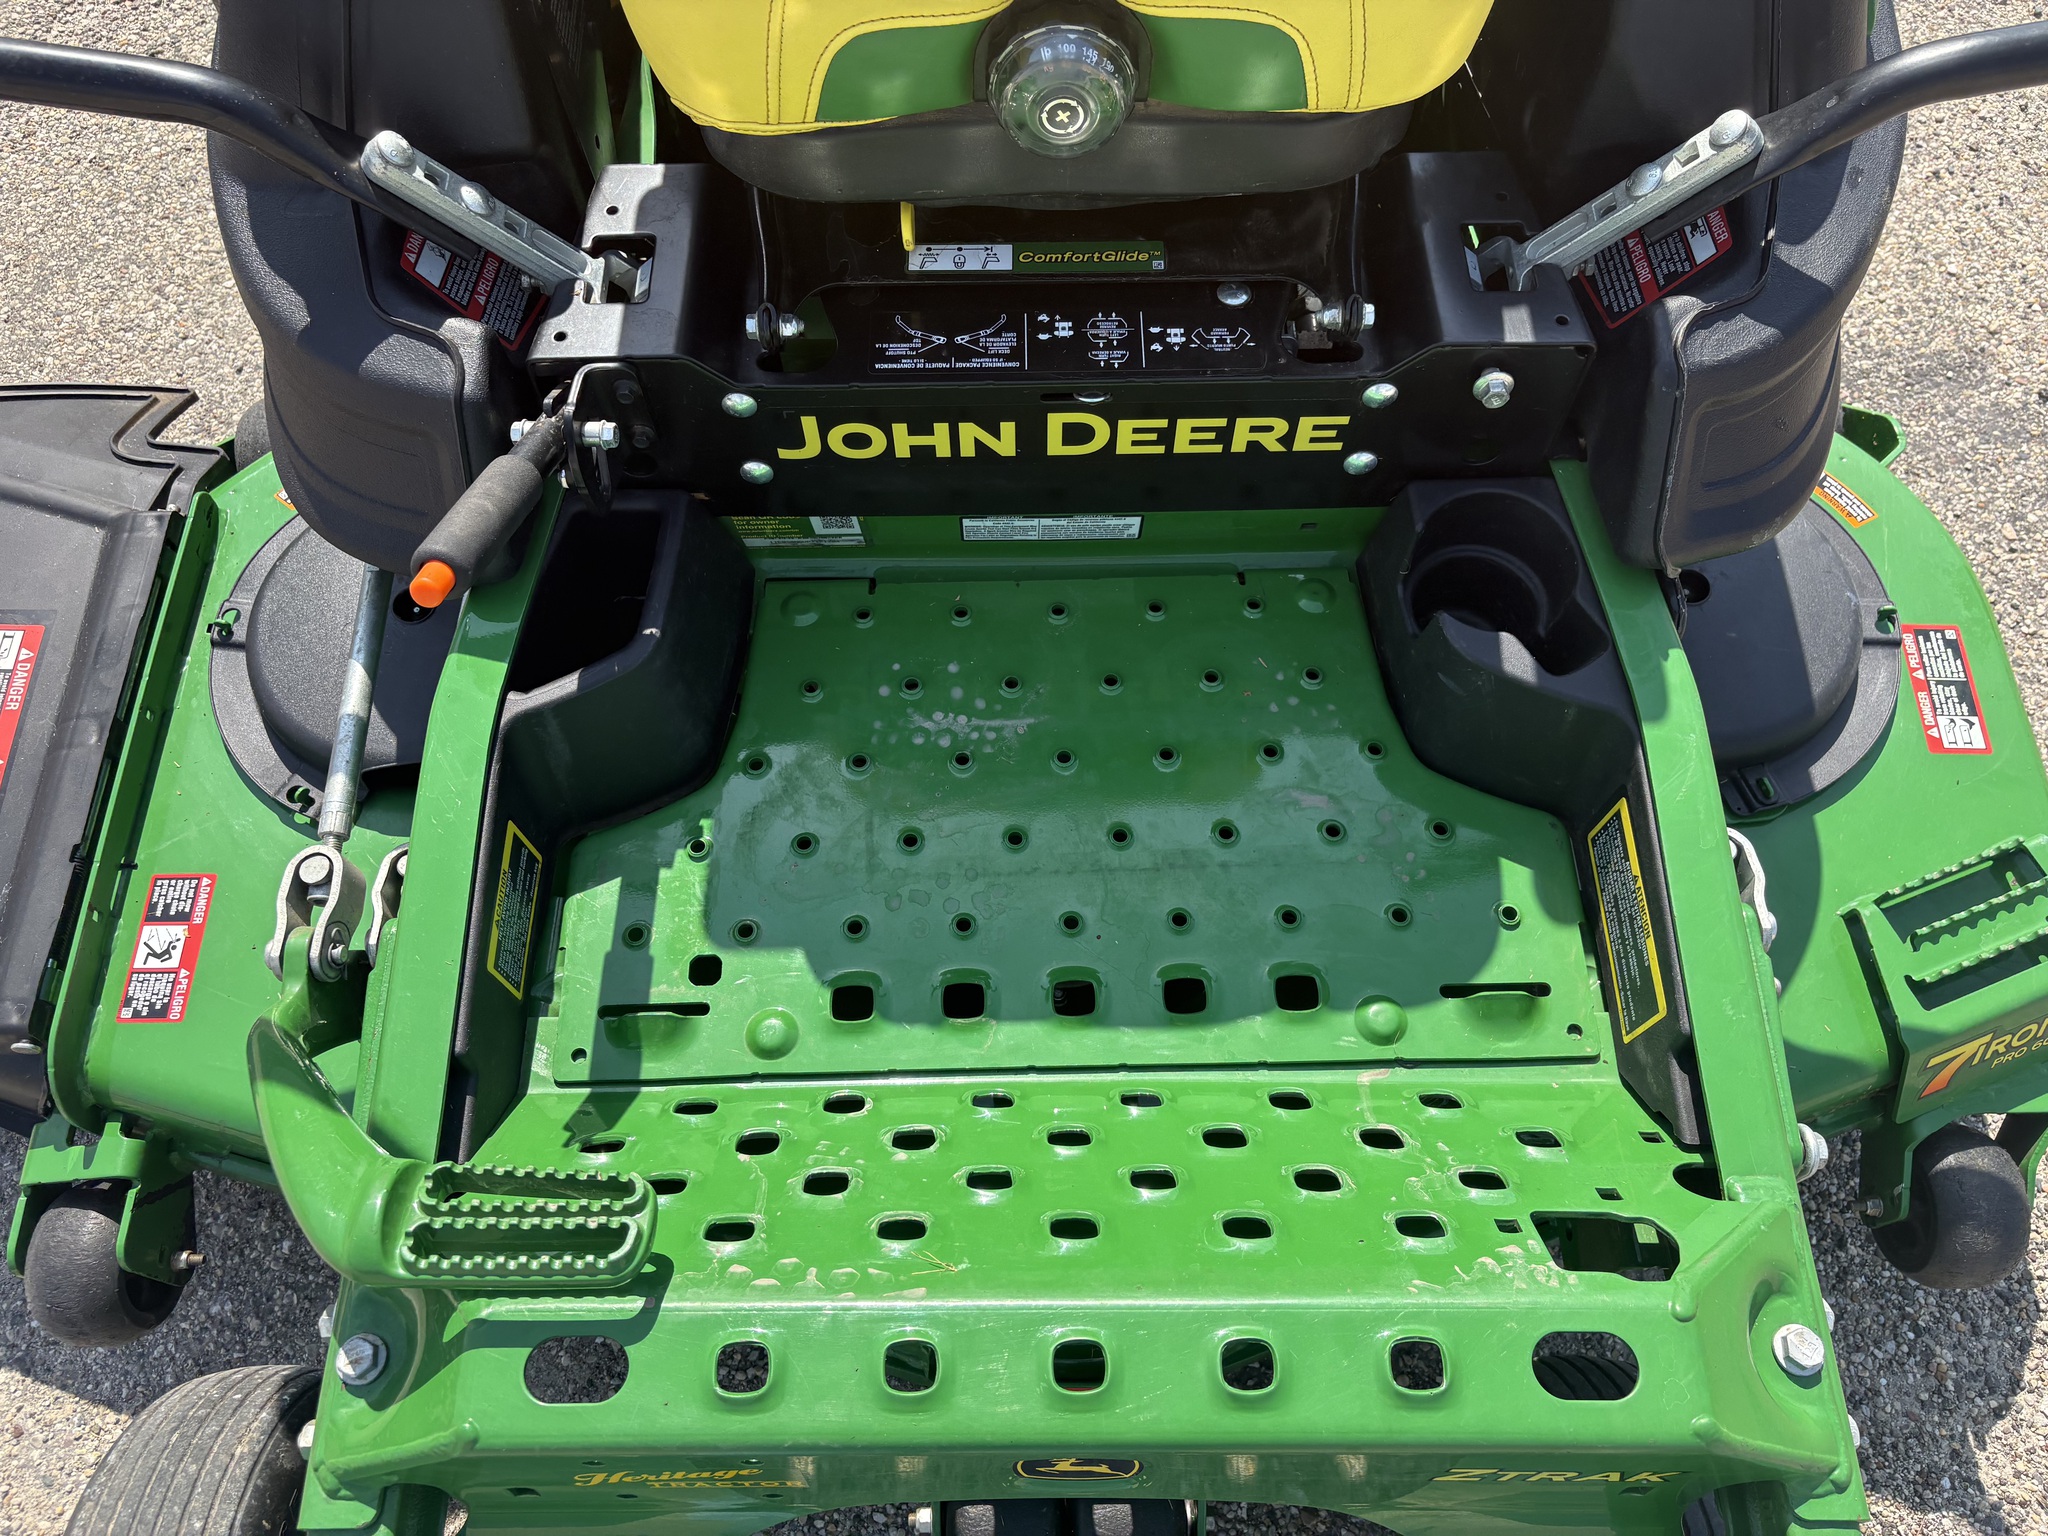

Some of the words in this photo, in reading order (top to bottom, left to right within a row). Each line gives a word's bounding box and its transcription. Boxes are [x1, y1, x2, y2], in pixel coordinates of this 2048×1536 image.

[1057, 43, 1077, 53] 100
[1708, 211, 1727, 242] ANGER
[477, 258, 497, 295] PELIGRO
[1630, 245, 1650, 282] PELIGRO
[777, 415, 1017, 460] JOHN
[1046, 412, 1351, 456] DEERE
[1903, 633, 1919, 667] PELIGRO
[5, 663, 31, 711] DANGER
[1918, 692, 1934, 724] DANGER
[193, 887, 209, 923] DANGER
[496, 869, 506, 916] CAUTION
[170, 978, 187, 1018] PELIGRO
[1991, 1046, 2028, 1069] PRO
[573, 1468, 764, 1487] Heritage
[1431, 1468, 1681, 1483] ZTRAK
